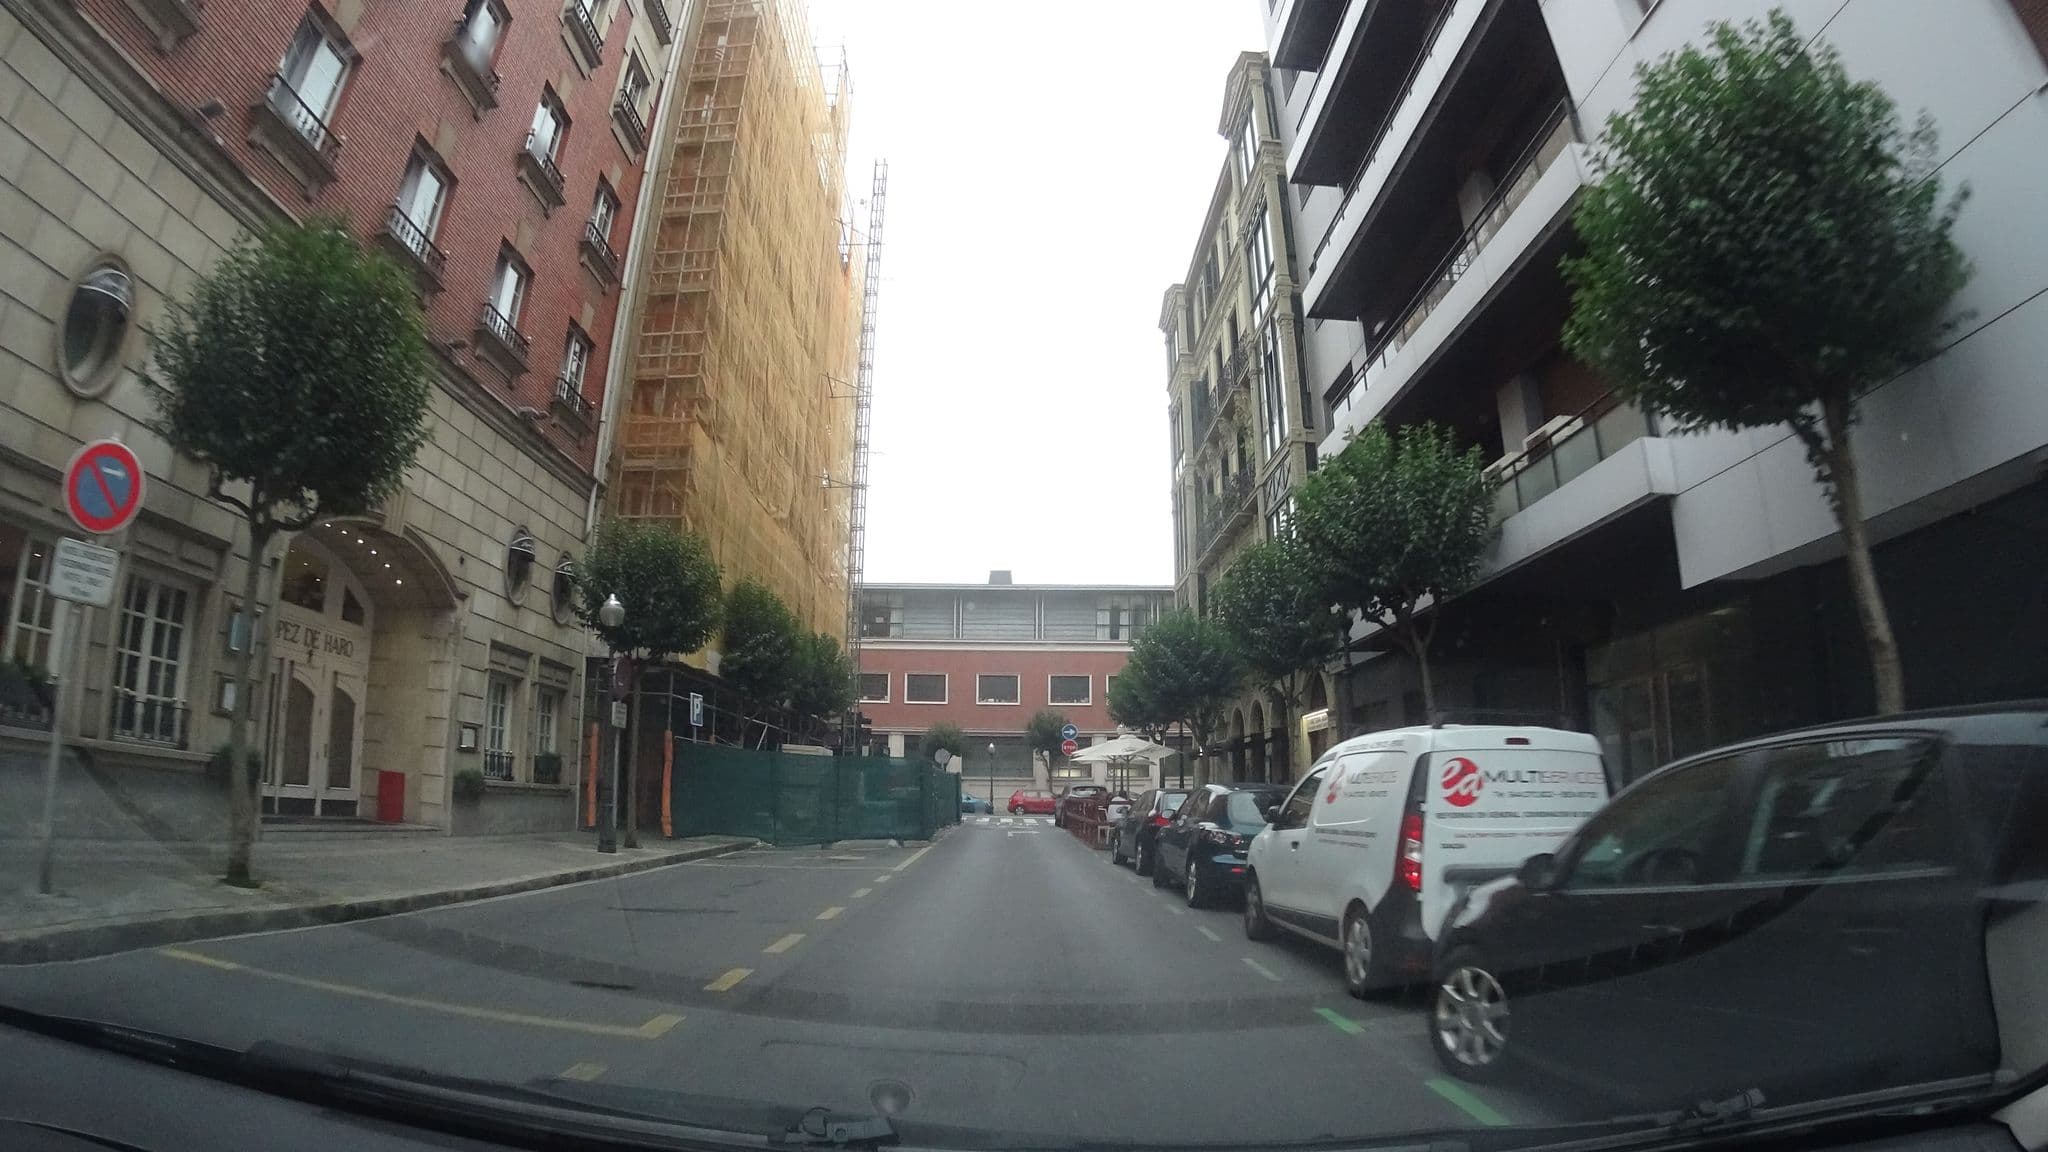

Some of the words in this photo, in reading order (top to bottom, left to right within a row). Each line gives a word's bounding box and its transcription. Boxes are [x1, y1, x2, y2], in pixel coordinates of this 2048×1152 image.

[304, 626, 321, 650] DE
[324, 632, 354, 658] HARO
[693, 697, 703, 722] P
